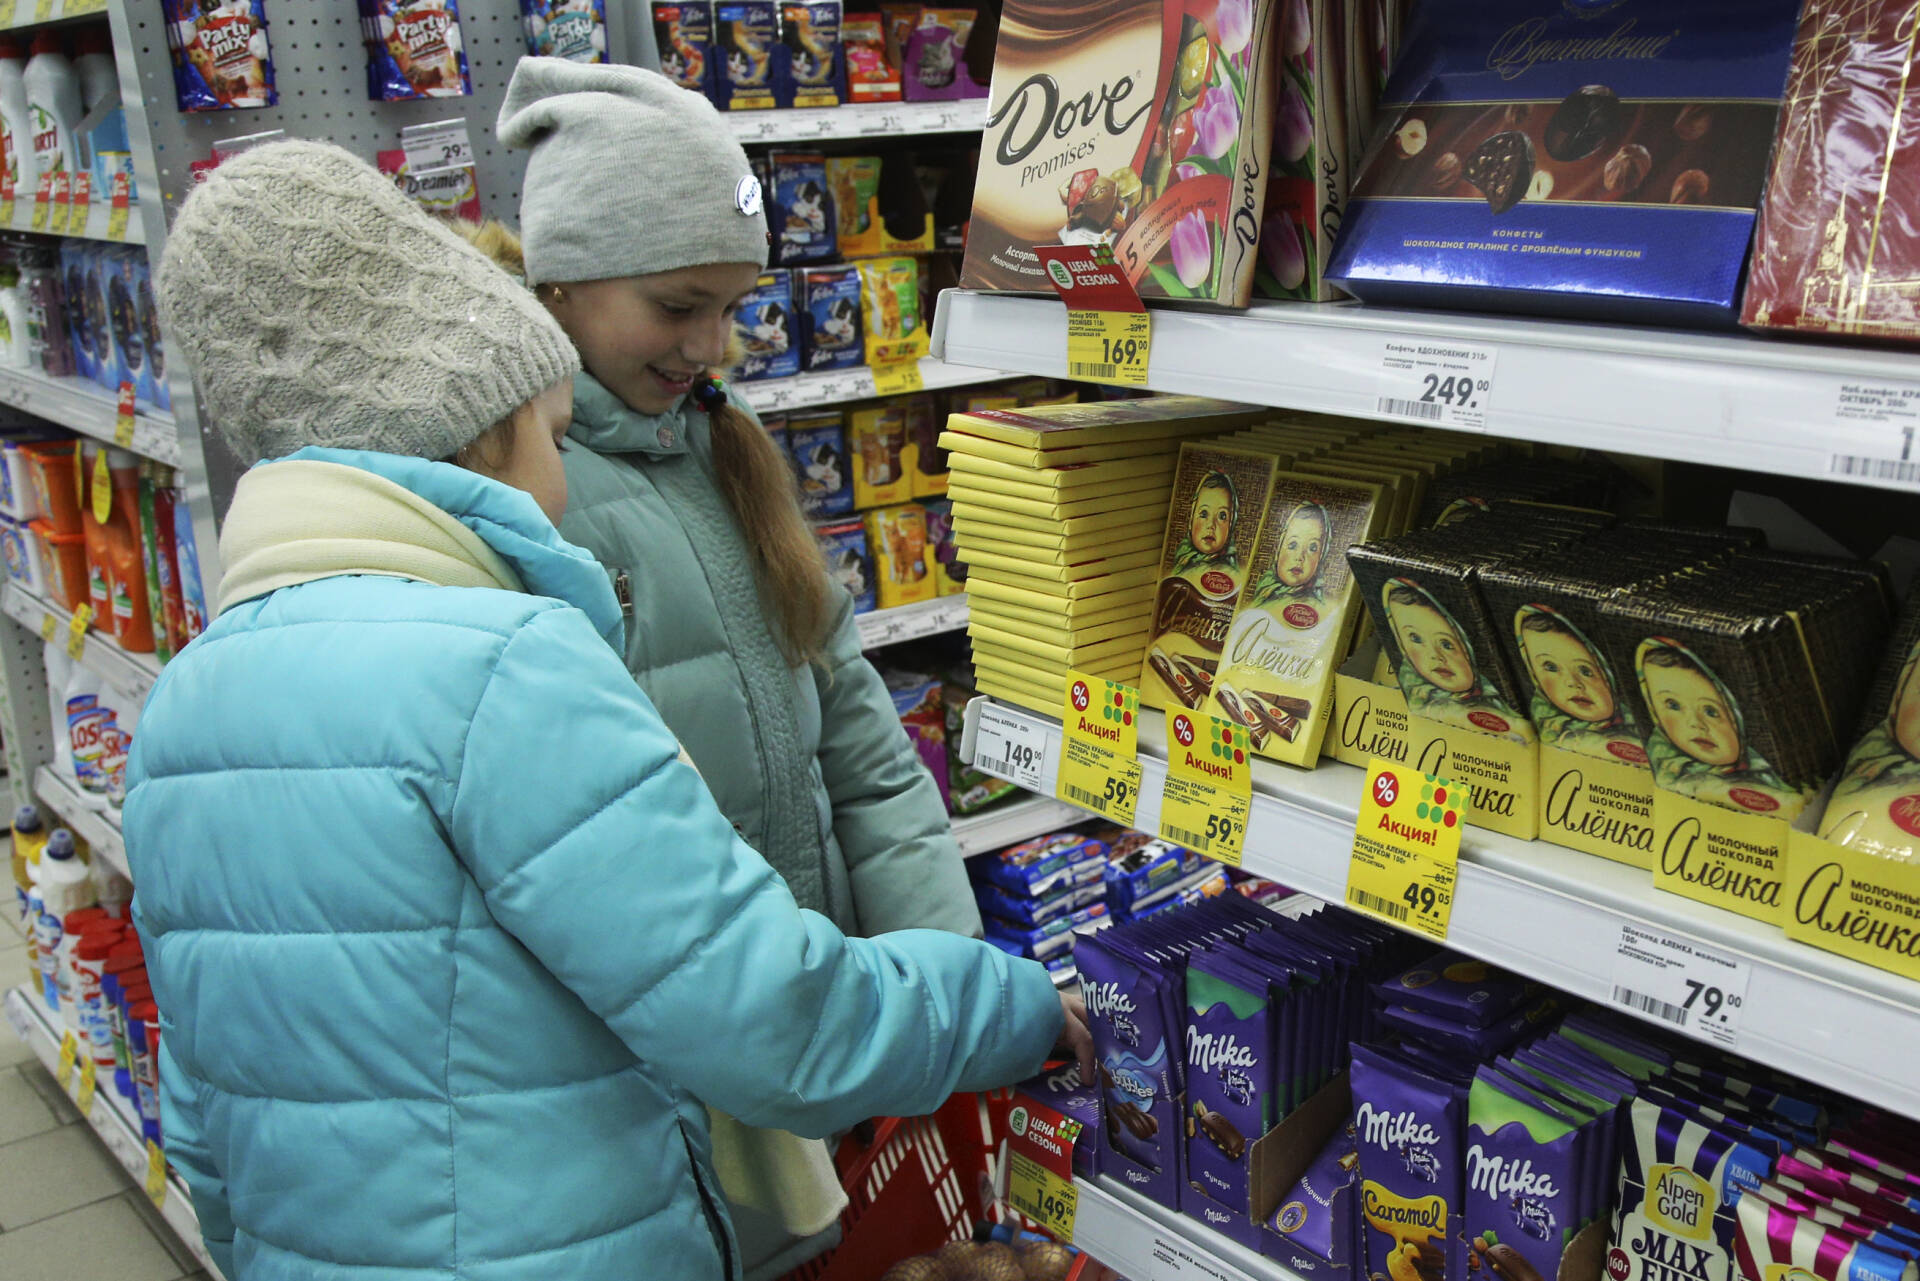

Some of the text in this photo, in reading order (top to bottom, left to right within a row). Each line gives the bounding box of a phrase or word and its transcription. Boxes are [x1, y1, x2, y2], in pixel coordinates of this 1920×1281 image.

[200, 20, 251, 50] Party
[212, 36, 248, 58] mix
[408, 29, 442, 51] mix
[986, 73, 1152, 166] Dove
[1021, 137, 1095, 187] Promises
[407, 171, 467, 194] Dreamies
[1234, 160, 1260, 246] Dove
[1492, 229, 1543, 239] КОНФЕТЫ
[1403, 239, 1641, 258] ШОКОЛАДНОЕ ПРАЛИНЕ С ДРОБЛЁНЫМ ФУНДУКОМ
[1067, 260, 1098, 275] ЦЕНА
[1076, 273, 1120, 286] СЕЗОНА
[1386, 343, 1416, 354] Конфеты
[1417, 346, 1470, 359] ВДОХНОВЕНИЕ
[1232, 617, 1314, 680] Алёнка
[1078, 716, 1121, 743] Акция!
[1185, 751, 1233, 781] Акция!
[1452, 751, 1512, 773] молочный
[1453, 762, 1509, 784] шоколад
[1164, 780, 1188, 794] ОКТЯБРЬ
[1190, 780, 1217, 796] КРАСНЫЙ
[1589, 783, 1654, 807] молочный
[1546, 768, 1654, 853] Алёнка
[1589, 794, 1650, 818] шоколад
[1378, 813, 1438, 847] Акция!
[1354, 840, 1391, 860] ФУНДУКОМ
[1385, 843, 1412, 859] АЛЕНКА
[1707, 831, 1780, 858] молочный
[1707, 842, 1774, 871] шоколад
[1661, 816, 1781, 908] Алёнка
[1622, 925, 1659, 944] Шоколад
[1660, 938, 1693, 955] АЛЕНКА
[1078, 972, 1136, 1017] Milka
[1186, 1024, 1258, 1074] Milka
[1112, 1068, 1155, 1098] bubbles
[1030, 1116, 1056, 1138] ЦЕНА
[1357, 1102, 1440, 1152] Milka
[1028, 1131, 1063, 1157] СЕЗОНА
[1126, 1169, 1150, 1183] Milka
[1466, 1144, 1560, 1201] Milka
[1301, 1175, 1330, 1208] Молочный
[1656, 1172, 1704, 1208] Alpen
[1205, 1207, 1230, 1223] Milka
[1363, 1189, 1445, 1233] Caramel
[1657, 1196, 1698, 1227] Gold
[1291, 1255, 1315, 1270] Milka
[1631, 1226, 1714, 1281] MAX
